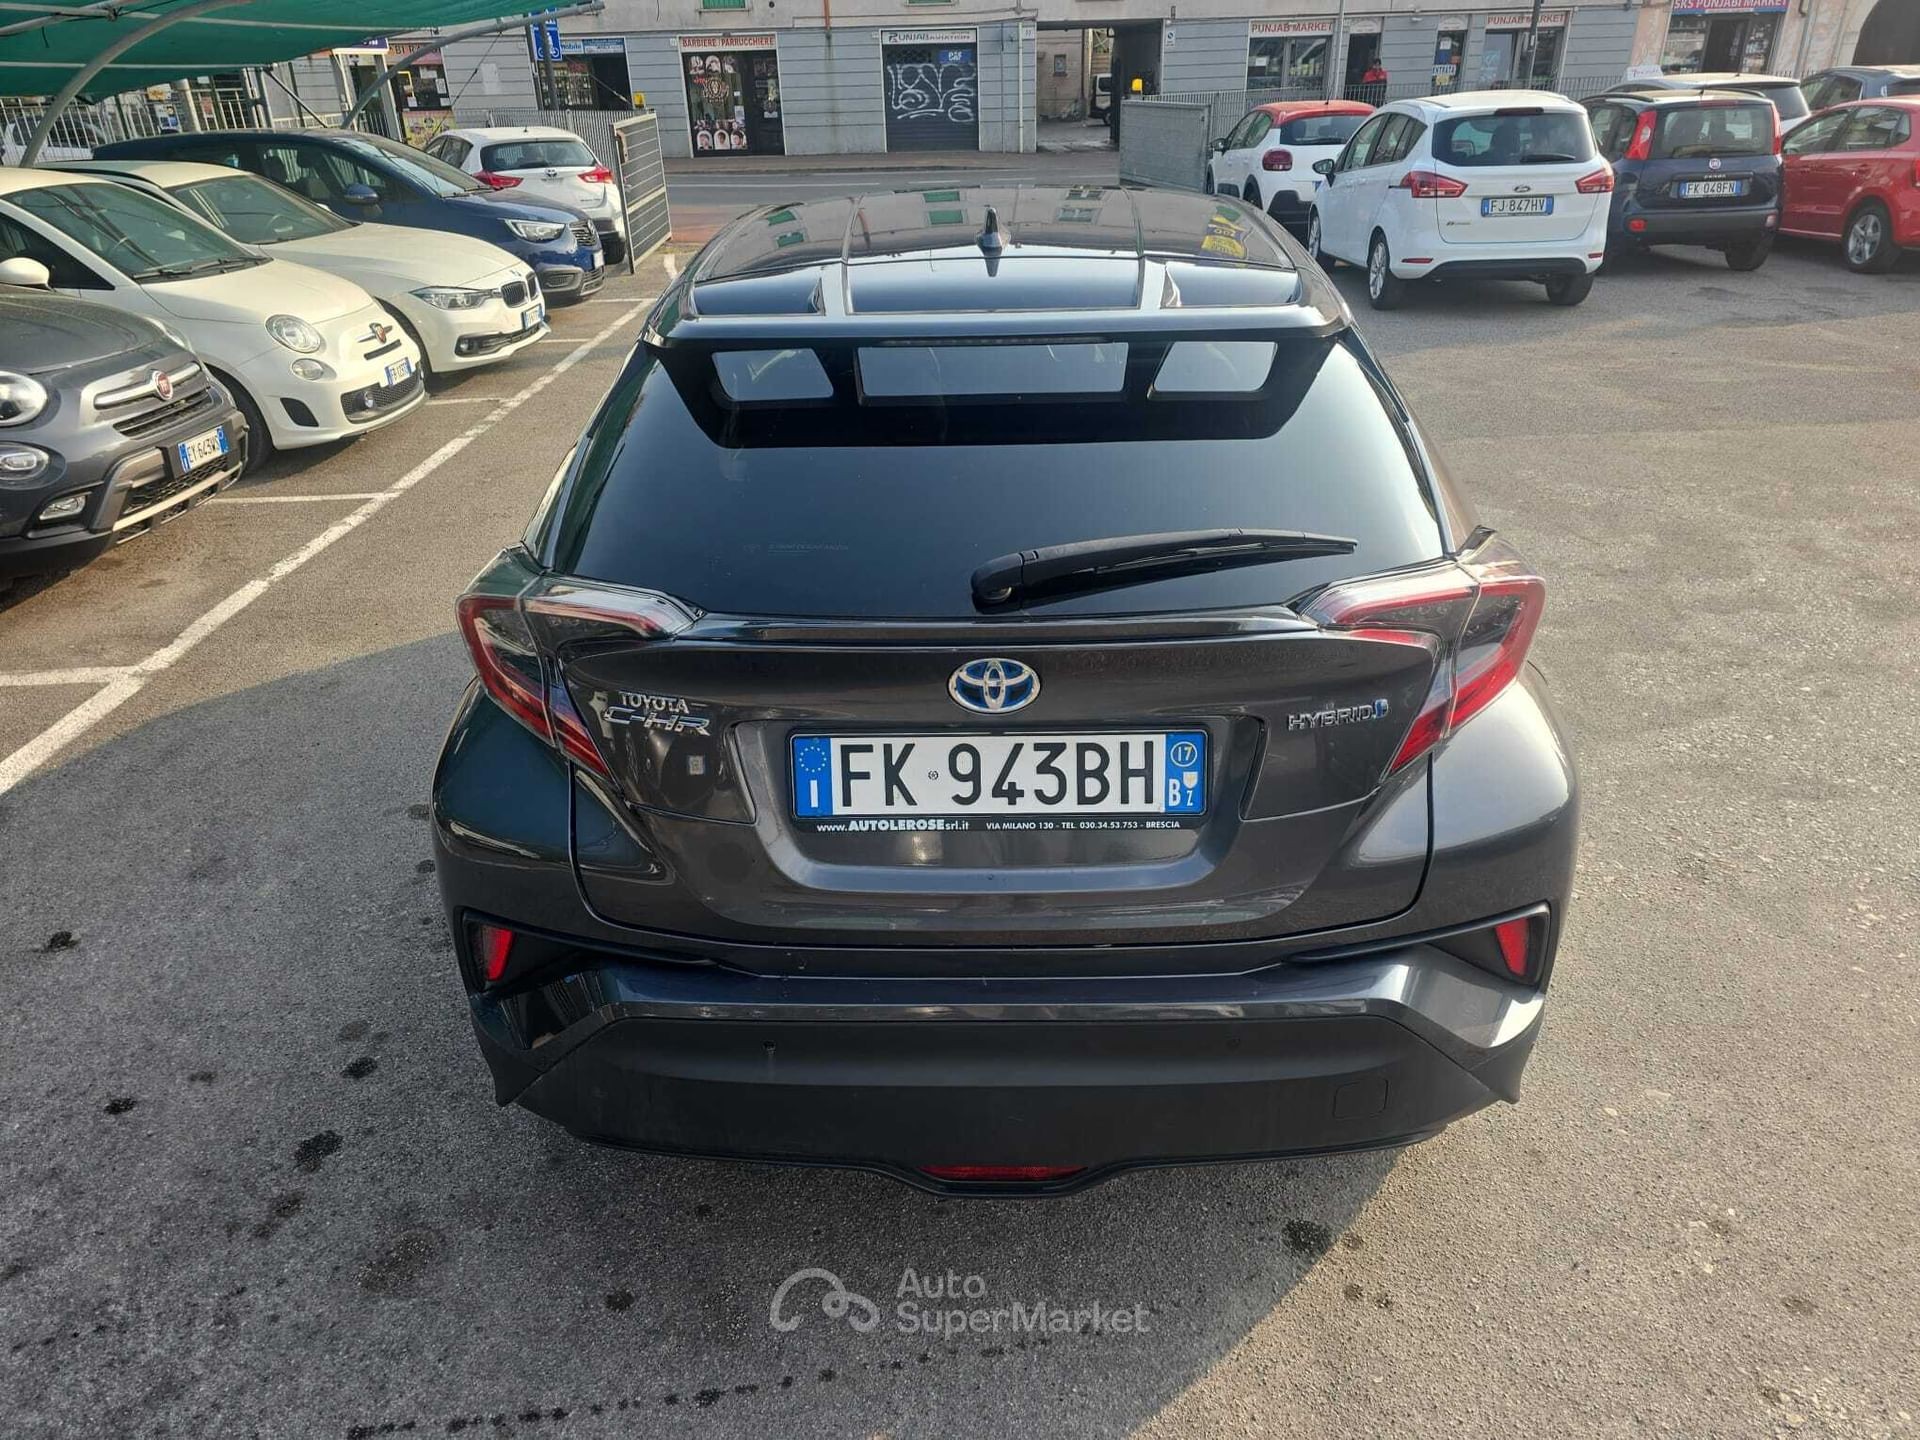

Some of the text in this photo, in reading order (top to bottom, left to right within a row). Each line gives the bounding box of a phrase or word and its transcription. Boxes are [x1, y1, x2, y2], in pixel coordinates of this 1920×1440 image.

[1674, 0, 1694, 9] SKS
[1696, 0, 1740, 8] PUNJABI
[1251, 21, 1333, 33] PUNJAB MARKET
[682, 38, 717, 47] BARBIERE
[721, 36, 775, 46] PARRUCCHIERE
[1687, 182, 1735, 194] FK 048FN
[1490, 199, 1545, 212] FJ 847HV
[619, 691, 689, 714] TOYOTA
[1288, 704, 1373, 731] HYBRID
[1177, 746, 1193, 762] 17
[840, 743, 918, 807] FK
[948, 740, 1154, 807] 943BH
[816, 819, 970, 832] www.AUTOLEROSEsrl.it
[1002, 822, 1036, 830] MILANO
[1079, 821, 1139, 829] 030.34.53.753
[1146, 820, 1181, 829] BRESCIA
